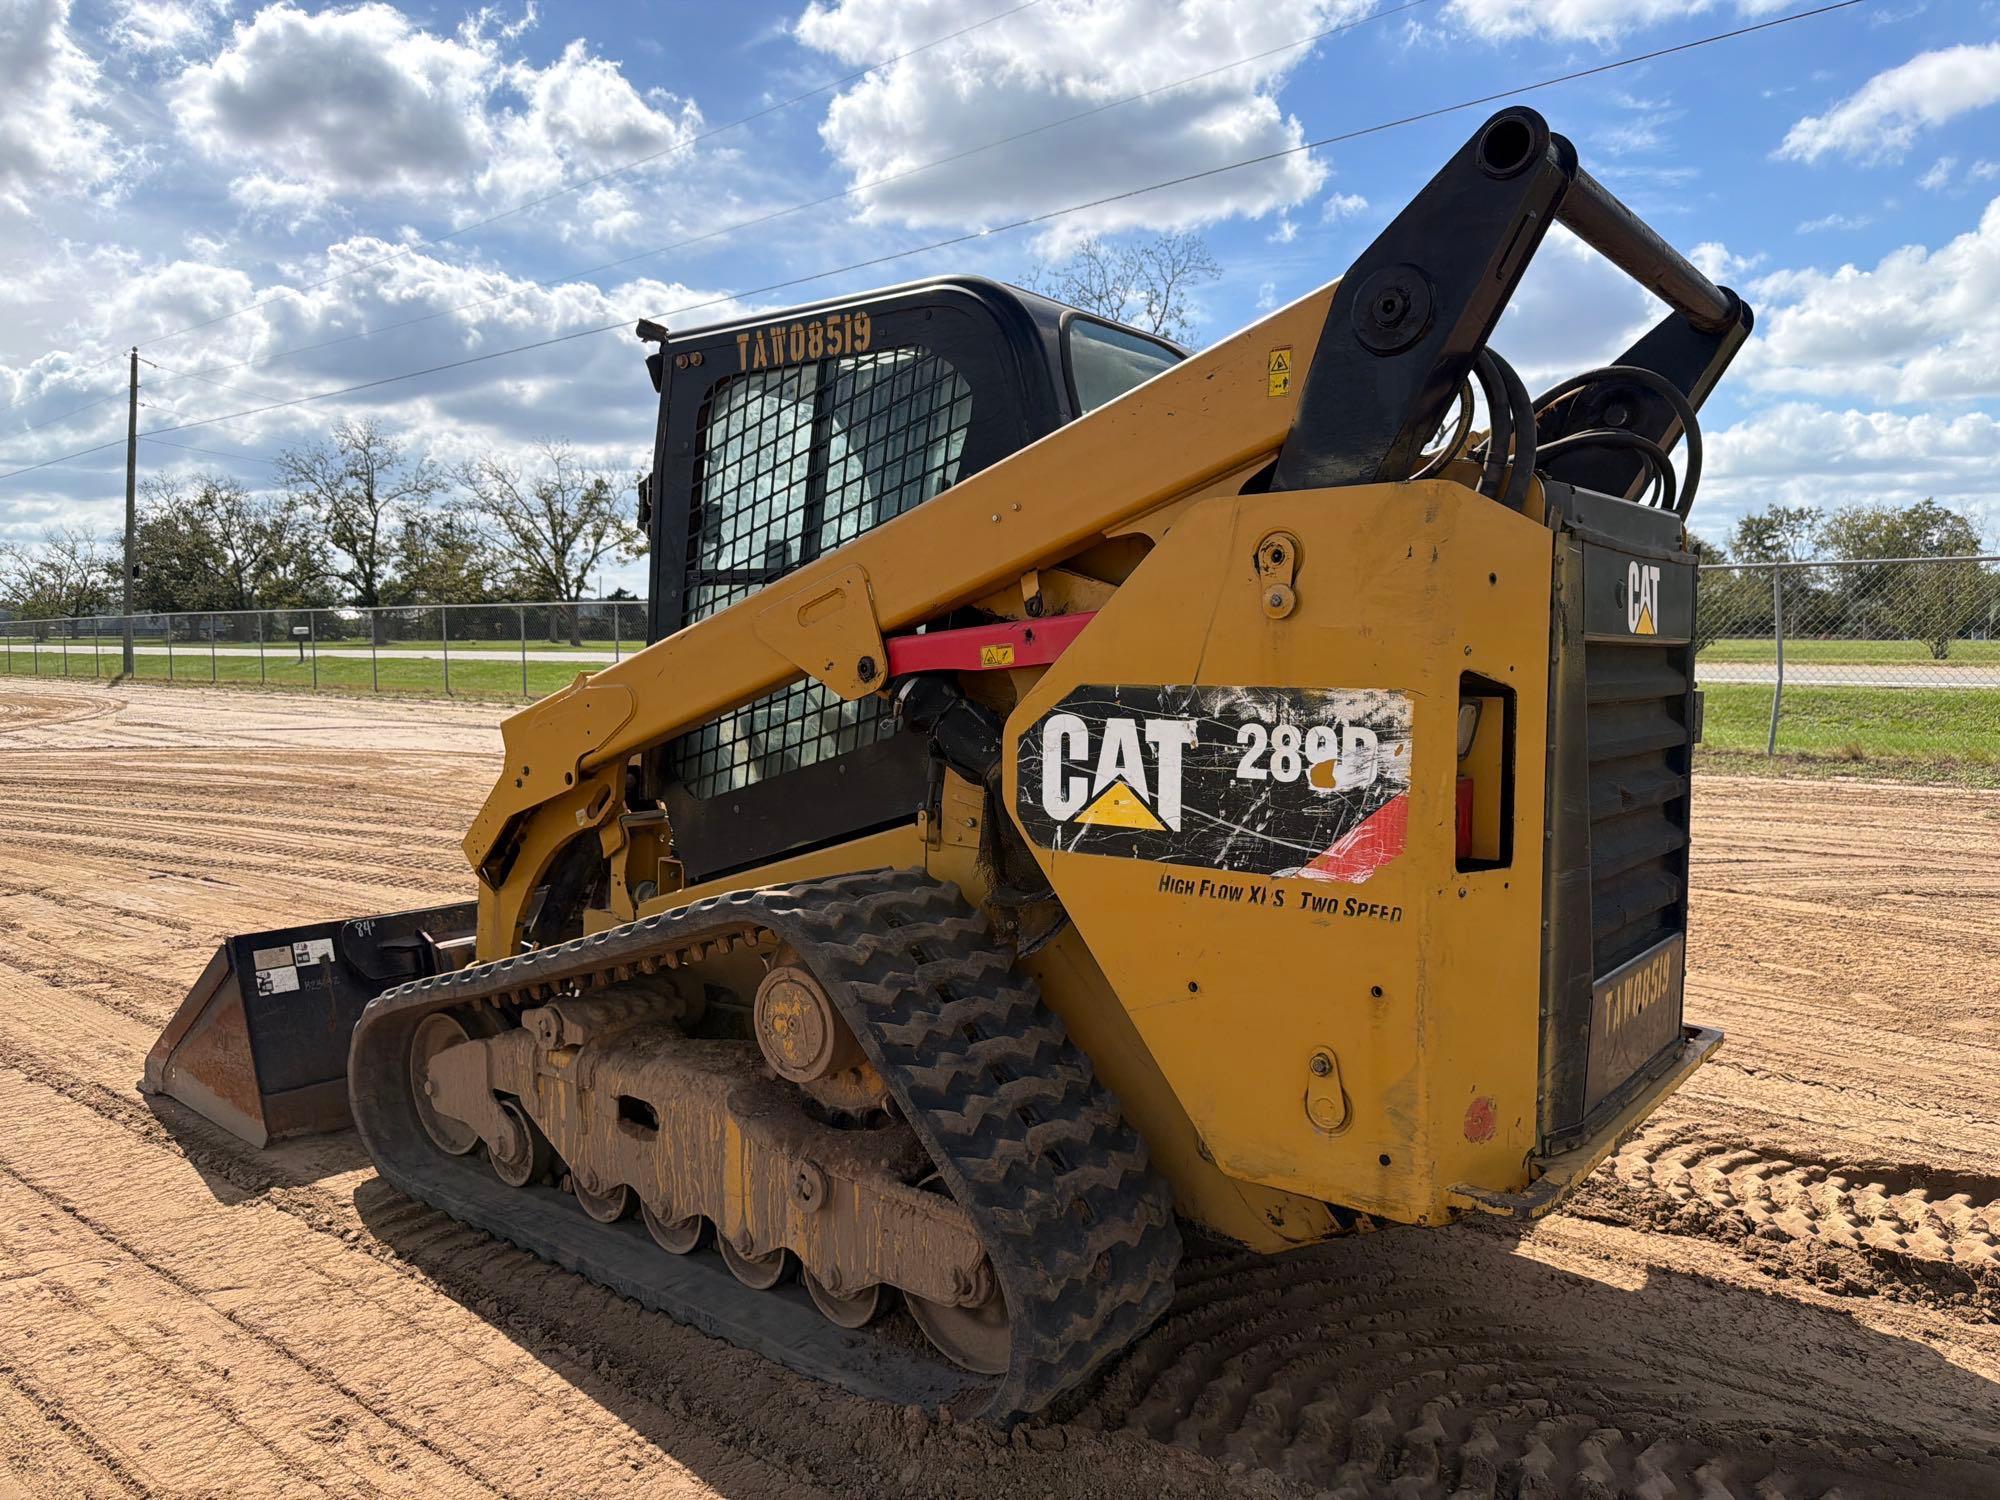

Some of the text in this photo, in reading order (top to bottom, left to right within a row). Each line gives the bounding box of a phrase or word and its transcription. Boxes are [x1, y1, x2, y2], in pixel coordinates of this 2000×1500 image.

[736, 311, 872, 371] TAW08519
[1628, 560, 1660, 635] CAT
[1041, 713, 1379, 833] CAT 289D
[1605, 951, 1671, 1038] TAW08519
